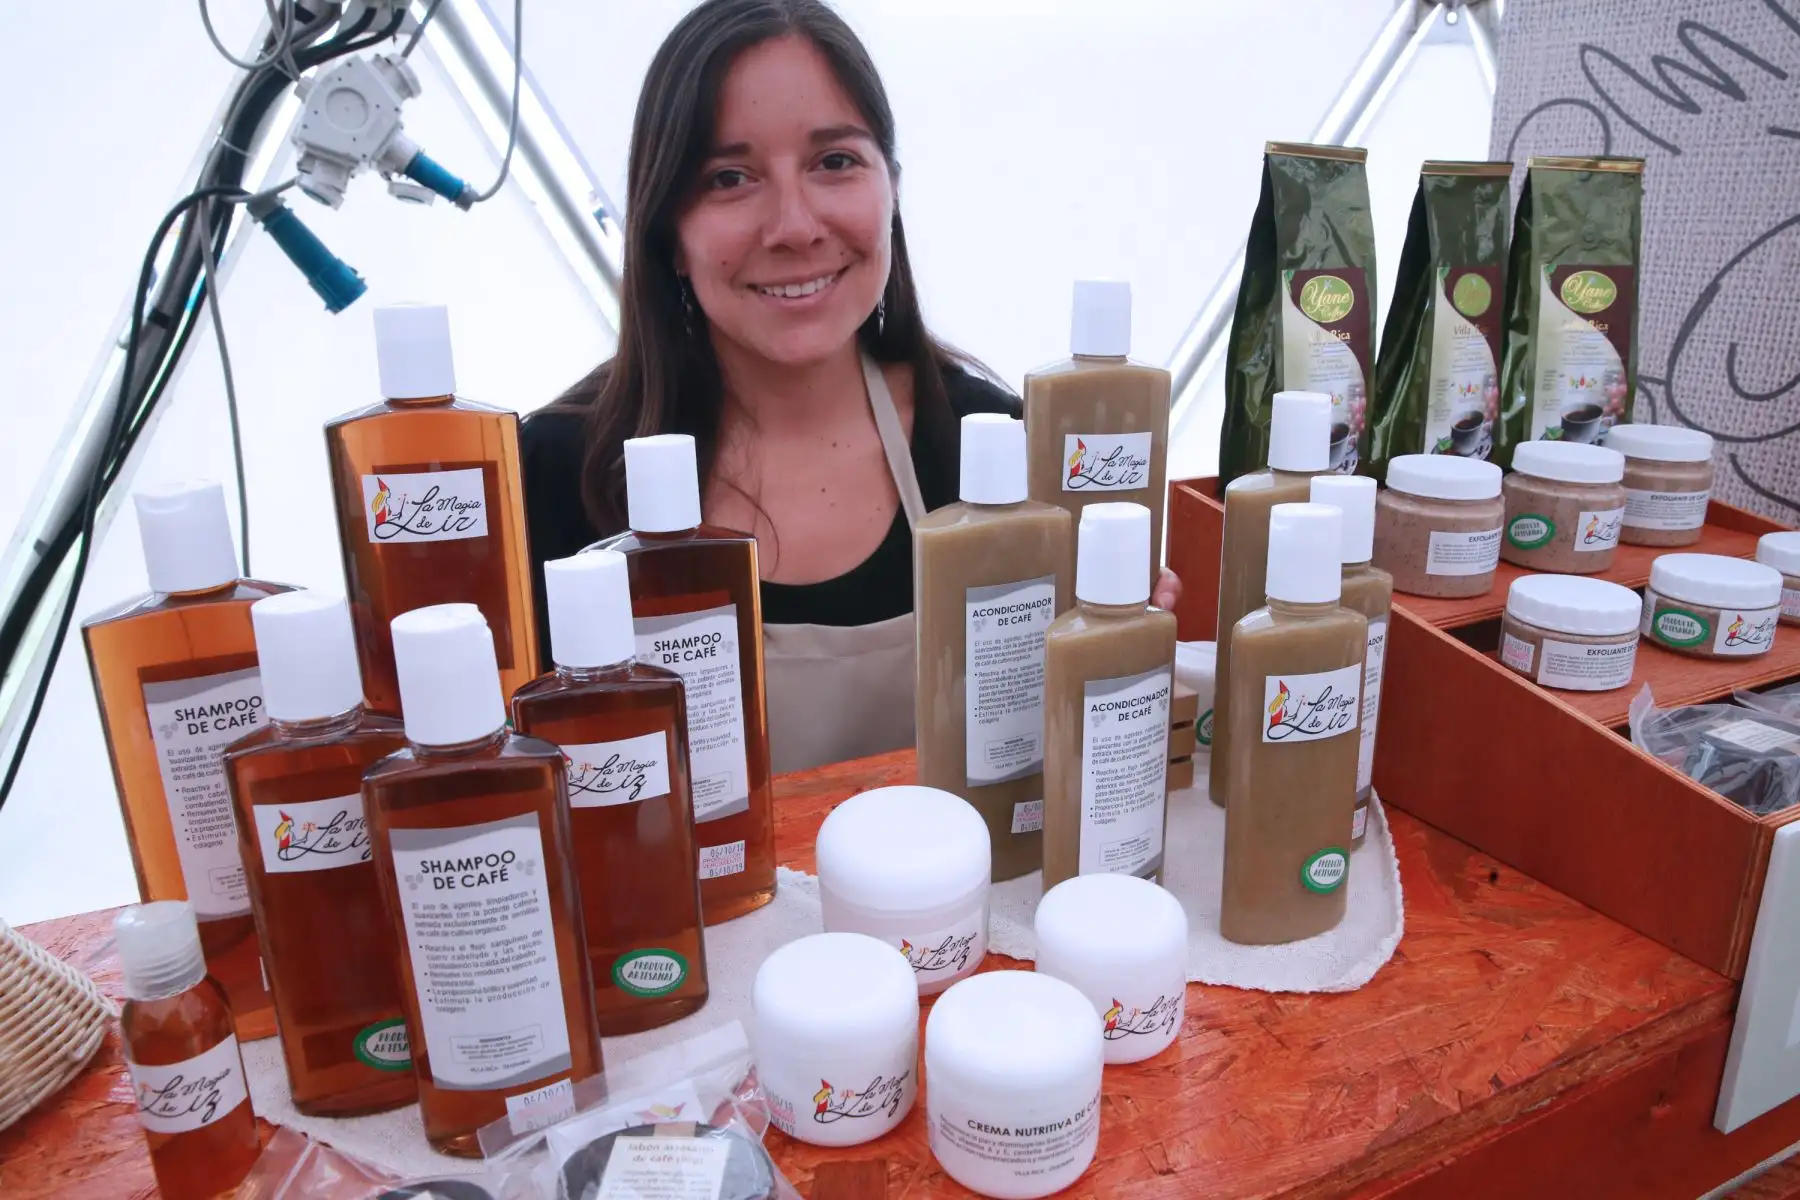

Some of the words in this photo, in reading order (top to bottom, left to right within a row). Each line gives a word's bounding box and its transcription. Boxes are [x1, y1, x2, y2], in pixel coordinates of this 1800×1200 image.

[436, 496, 482, 514] Magia
[972, 597, 1052, 618] ACONDICIONADOR
[998, 618, 1008, 626] DE
[1011, 612, 1032, 624] CAFÉ
[654, 632, 722, 652] SHAMPOO
[1586, 646, 1626, 656] EXFOLIANTE
[662, 653, 680, 664] DE
[683, 644, 716, 660] CAFÉ
[174, 696, 262, 722] SHAMPOO
[1091, 686, 1168, 712] ACONDICIONADOR
[188, 723, 208, 736] DE
[214, 710, 258, 732] CAFÉ
[1118, 712, 1130, 722] DE
[1132, 706, 1152, 719] CAFÉ
[420, 850, 516, 875] SHAMPOO
[433, 876, 455, 890] DE
[461, 865, 509, 888] CAFÉ
[967, 1119, 1011, 1138] CREMA
[1015, 1117, 1072, 1137] NUTRITIVA
[1074, 1108, 1086, 1122] DE
